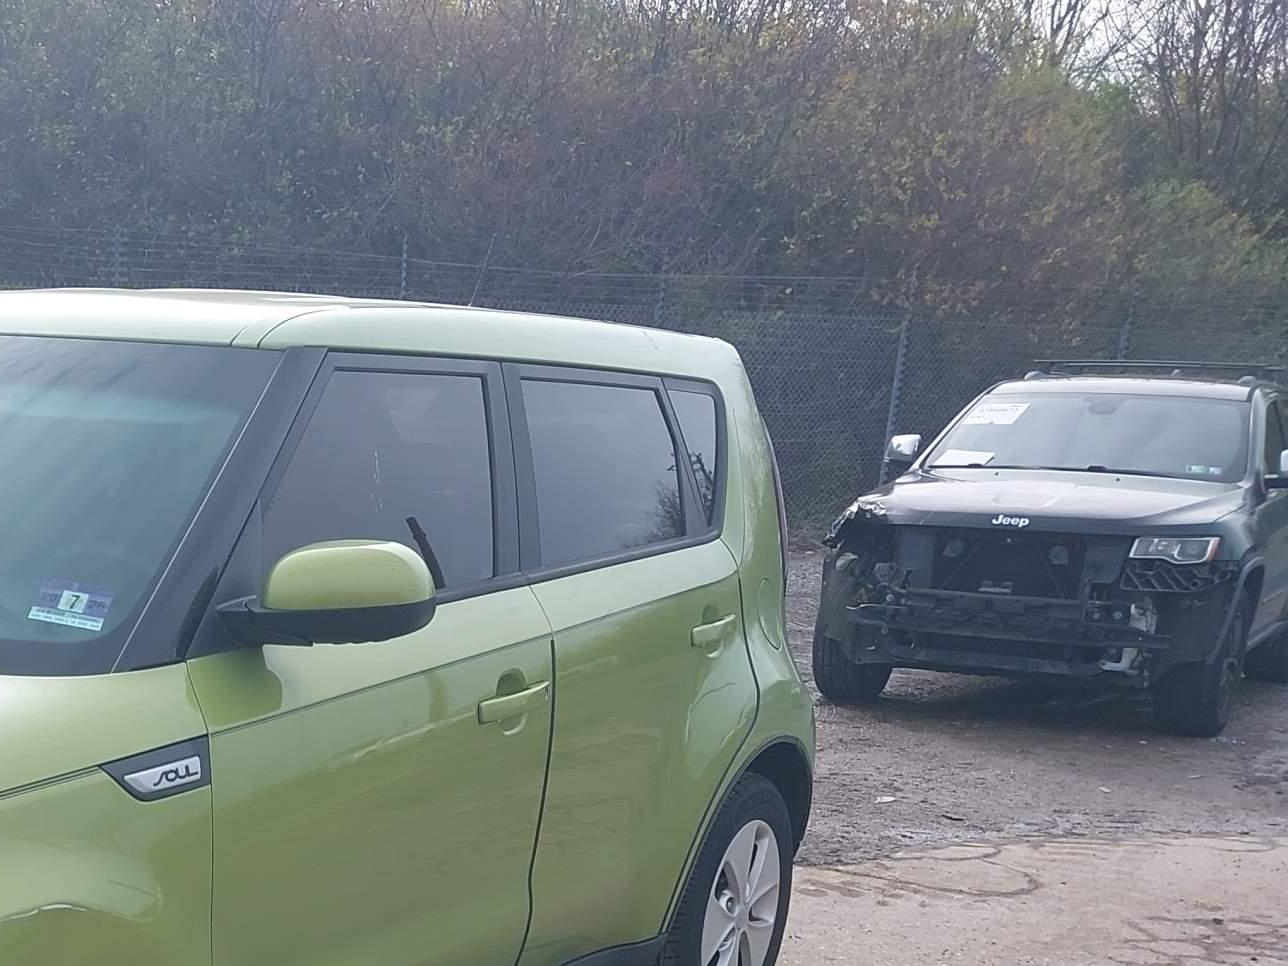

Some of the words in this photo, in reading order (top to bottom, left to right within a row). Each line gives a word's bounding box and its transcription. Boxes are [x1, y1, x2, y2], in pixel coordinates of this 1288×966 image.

[991, 514, 1030, 529] Jeep
[69, 594, 80, 609] 7
[152, 765, 199, 787] SOUL
